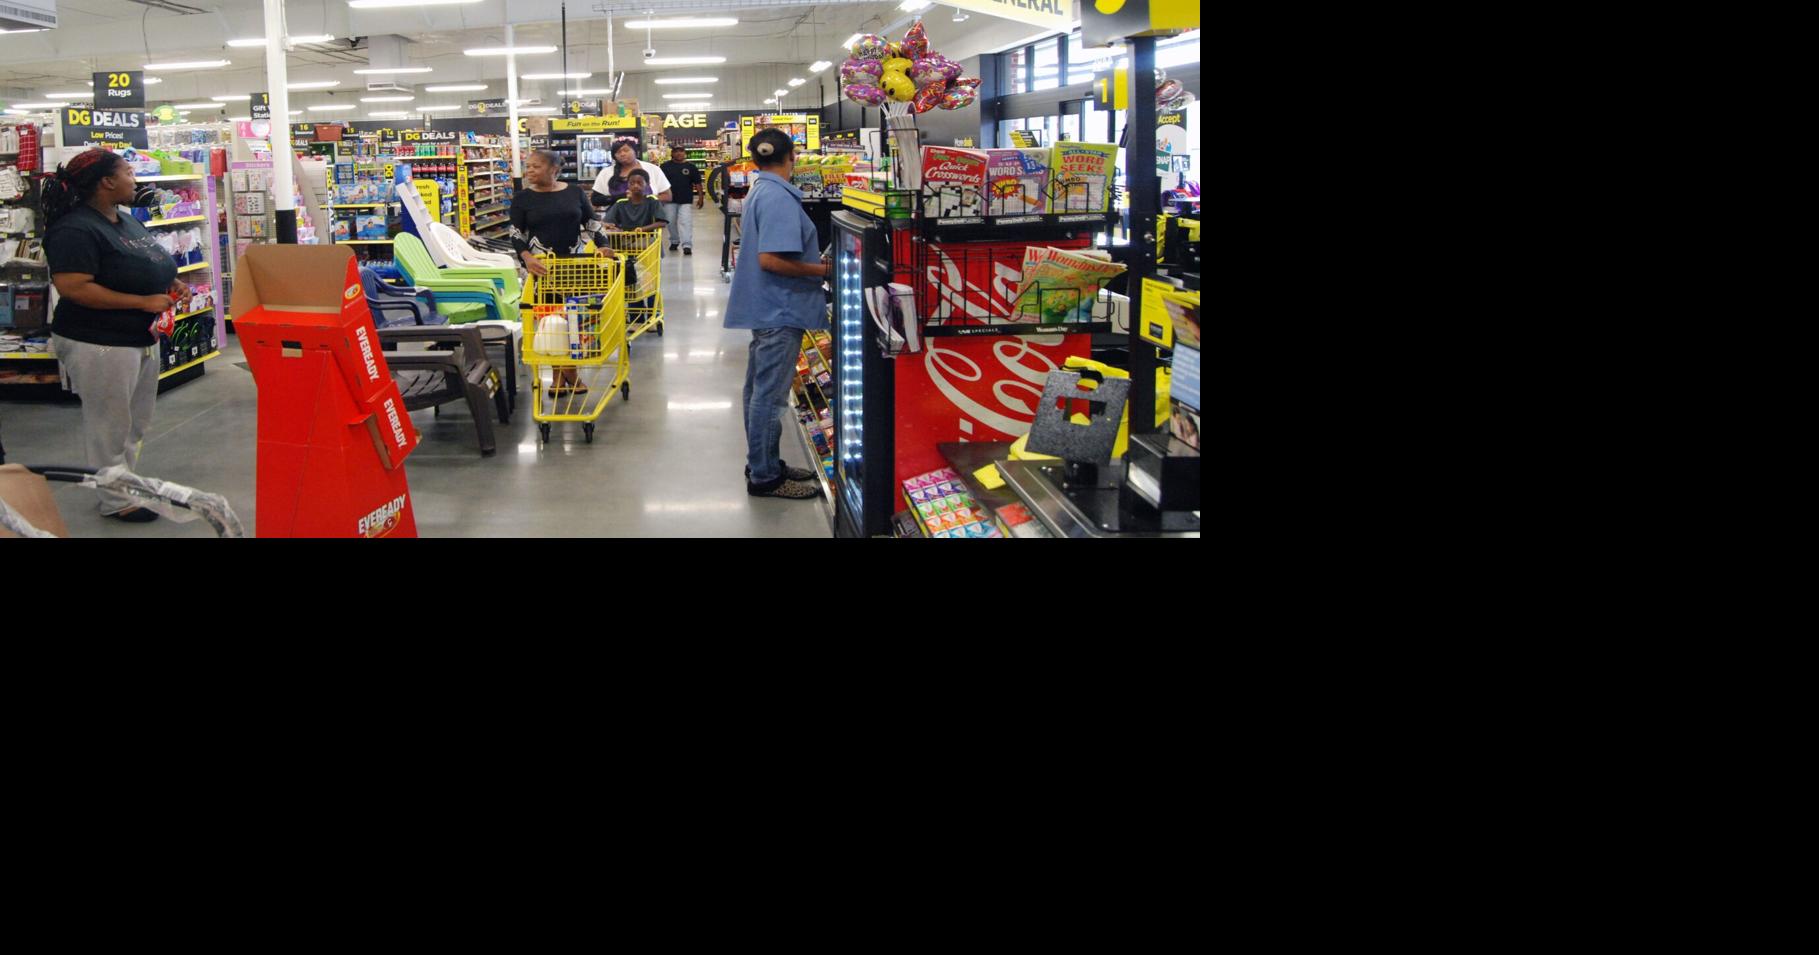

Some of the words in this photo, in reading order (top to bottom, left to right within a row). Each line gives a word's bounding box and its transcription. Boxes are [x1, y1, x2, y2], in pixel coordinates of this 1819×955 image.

[108, 73, 130, 87] 20
[108, 89, 132, 98] Rugs
[1098, 78, 1108, 103] 1
[68, 109, 91, 126] DG
[93, 111, 140, 127] DEALS
[1158, 115, 1181, 125] Accept
[405, 132, 420, 141] DG
[422, 131, 456, 140] DEALS
[939, 161, 969, 171] Quick
[1026, 161, 1036, 169] 13
[1063, 154, 1104, 166] WORD
[924, 167, 982, 183] Crosswords
[989, 166, 1016, 176] WORD
[1060, 164, 1105, 174] SEEKS
[356, 326, 380, 383] EVEREADY
[384, 398, 407, 448] EVEREADY
[358, 494, 406, 535] EVEREADY
